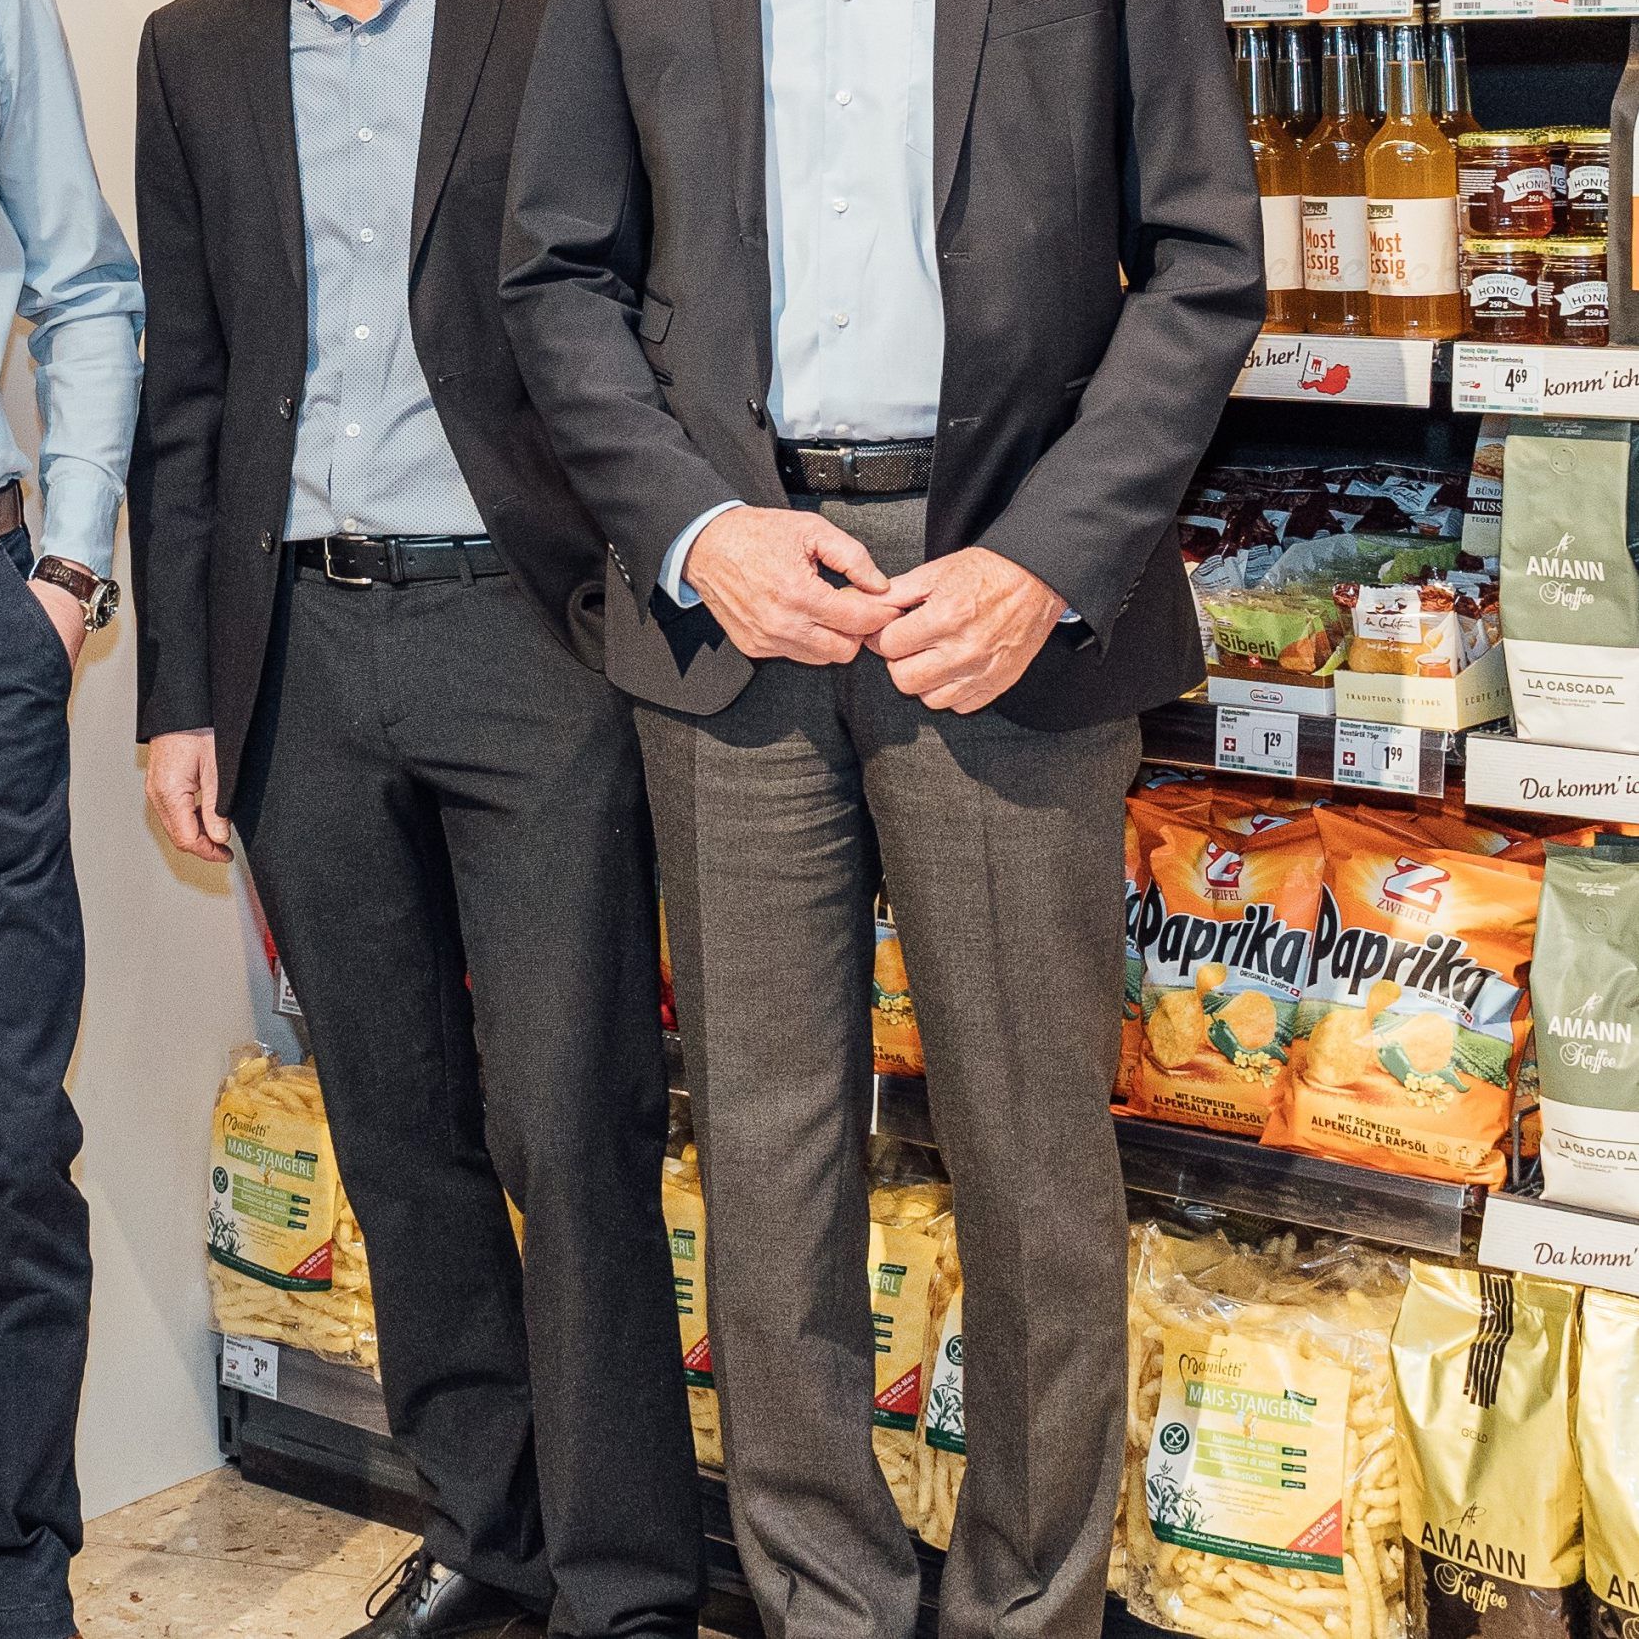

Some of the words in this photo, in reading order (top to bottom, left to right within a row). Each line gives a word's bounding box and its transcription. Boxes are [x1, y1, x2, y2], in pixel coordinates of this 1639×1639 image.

[1516, 179, 1550, 192] HONIG
[1305, 227, 1336, 248] Most
[1369, 231, 1402, 252] Most
[1306, 249, 1339, 275] Essig
[1371, 253, 1406, 280] Essig
[1479, 285, 1520, 297] HONIG
[1572, 294, 1608, 306] HONI
[1242, 350, 1263, 368] ch
[1266, 342, 1302, 366] her!
[1505, 368, 1527, 392] 469
[1544, 370, 1609, 397] komm'
[1526, 556, 1605, 581] AMANN
[1539, 580, 1594, 611] Kaffee
[1219, 632, 1276, 658] Biberli
[1346, 693, 1392, 703] TRADITION
[1528, 678, 1544, 690] LA
[1547, 680, 1615, 696] CASCADA
[1263, 732, 1282, 754] 129
[1384, 746, 1403, 769] 199
[1520, 778, 1553, 800] Da
[1557, 775, 1622, 798] komm'
[1626, 775, 1639, 794] ic
[1376, 897, 1434, 926] ZWEIFEL
[1137, 877, 1307, 986] Paprika
[1307, 882, 1497, 1011] Paprika
[1240, 969, 1269, 984] ORIGINAL
[1547, 1015, 1632, 1044] AMANN
[1560, 1041, 1616, 1074] Kaffee
[1153, 1094, 1209, 1115] ALPENSALZ
[1223, 1109, 1263, 1124] RAPSÖL
[1175, 1091, 1189, 1101] MIT
[1191, 1095, 1236, 1111] SCHWEIZER
[1311, 1115, 1371, 1140] ALPENSALZ
[1375, 1133, 1382, 1142] &
[1386, 1135, 1429, 1154] RAPSÖL
[1337, 1113, 1352, 1122] MIT
[1356, 1114, 1401, 1137] SCHWEIZER
[227, 1138, 313, 1178] MAIS-STANGERL
[1558, 1137, 1573, 1150] LA
[1573, 1141, 1638, 1162] CASCADA
[1534, 1242, 1566, 1265] Da
[1570, 1245, 1638, 1267] komm'
[1188, 1383, 1312, 1424] MAIS-STANGERL
[1461, 1427, 1488, 1444] GOLD
[1420, 1521, 1526, 1580] AMANN
[1434, 1562, 1507, 1613] Kaffee
